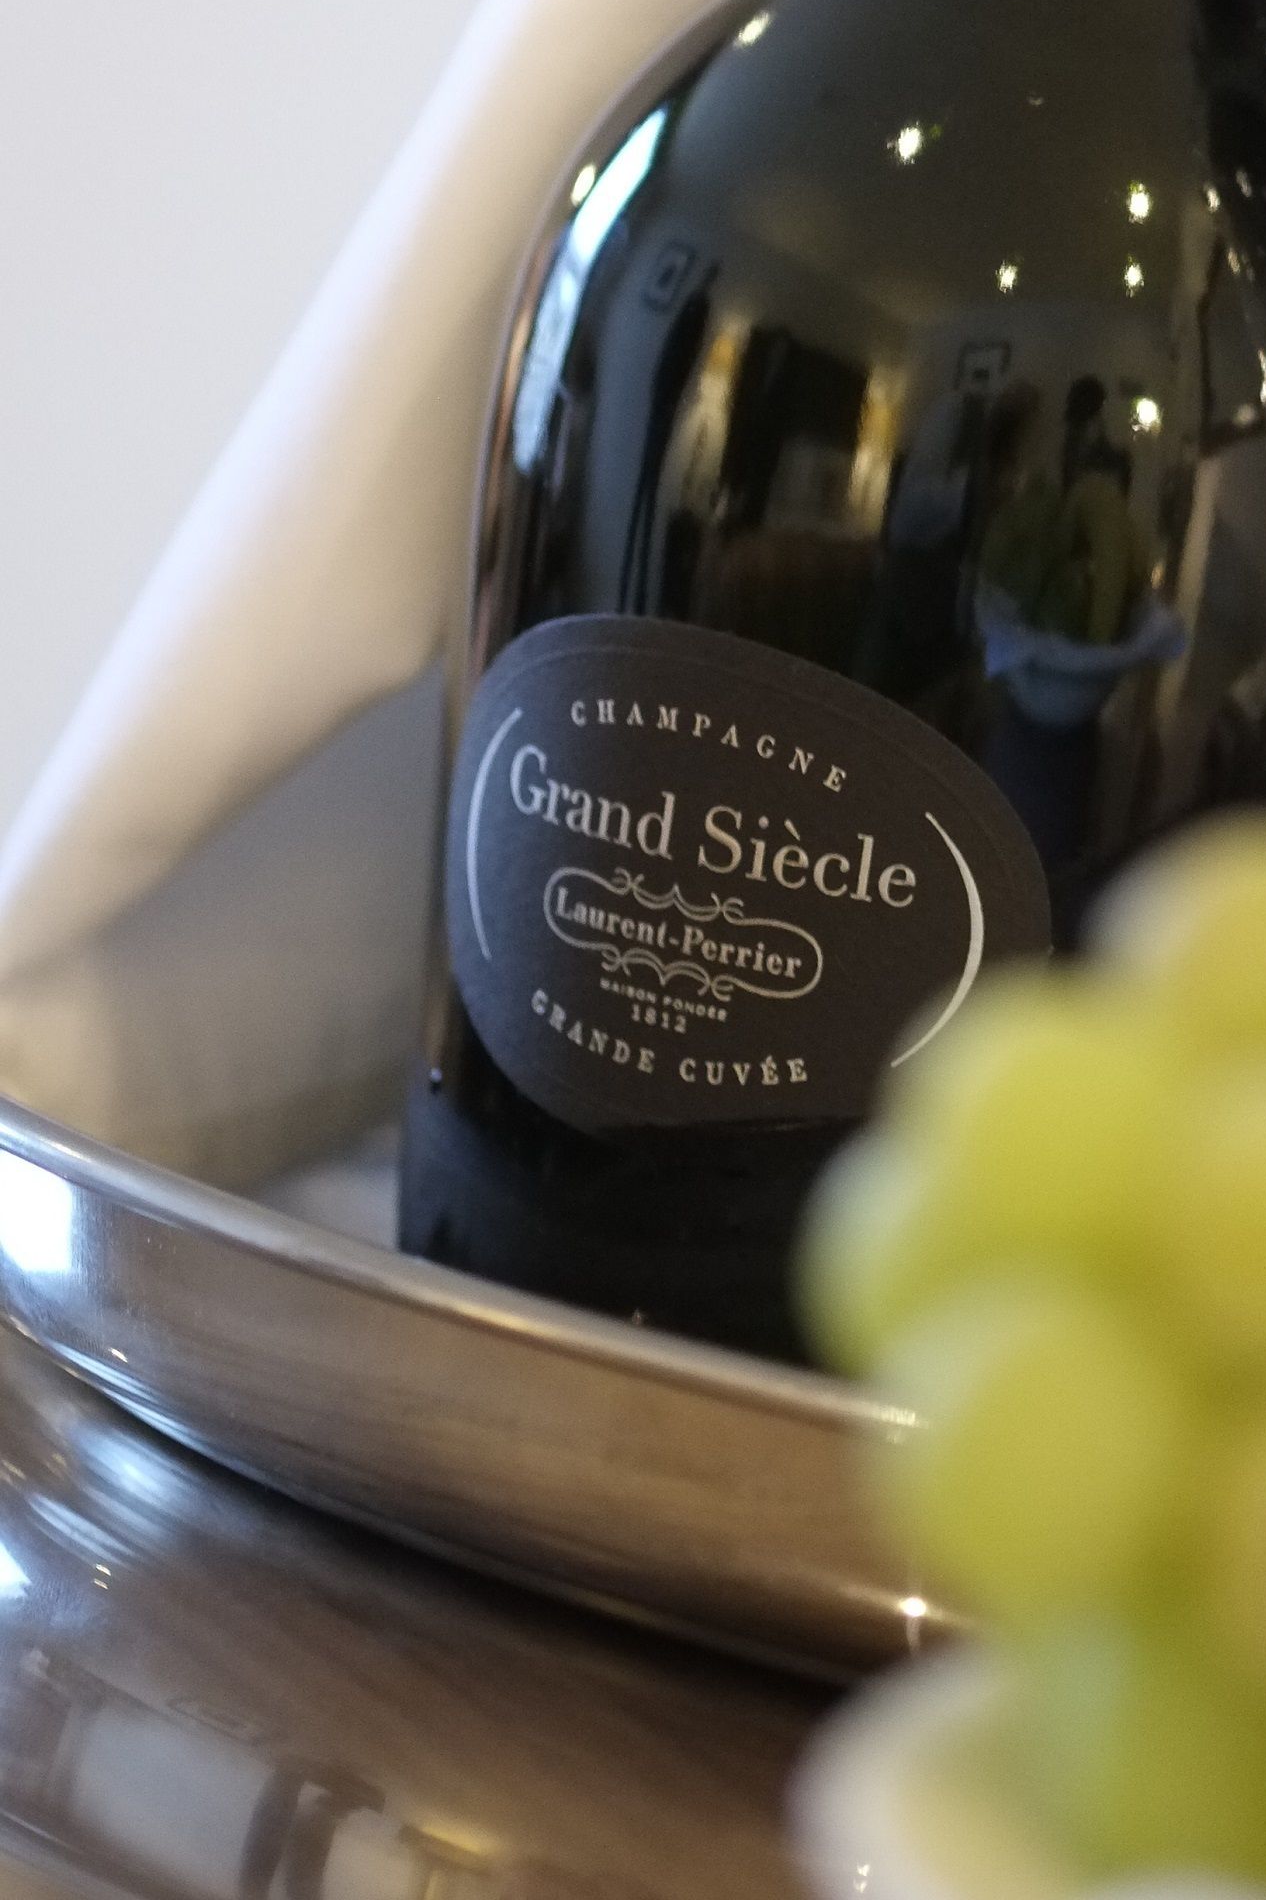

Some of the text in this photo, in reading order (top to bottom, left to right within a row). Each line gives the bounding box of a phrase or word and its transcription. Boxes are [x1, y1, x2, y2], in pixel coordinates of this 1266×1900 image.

[571, 699, 847, 792] CHAMPAGNE
[509, 744, 917, 908] Grand Siècle
[556, 887, 802, 979] Laurent-Perrier
[531, 988, 809, 1086] GRANDE CUVÉE
[631, 1003, 687, 1034] 1812
